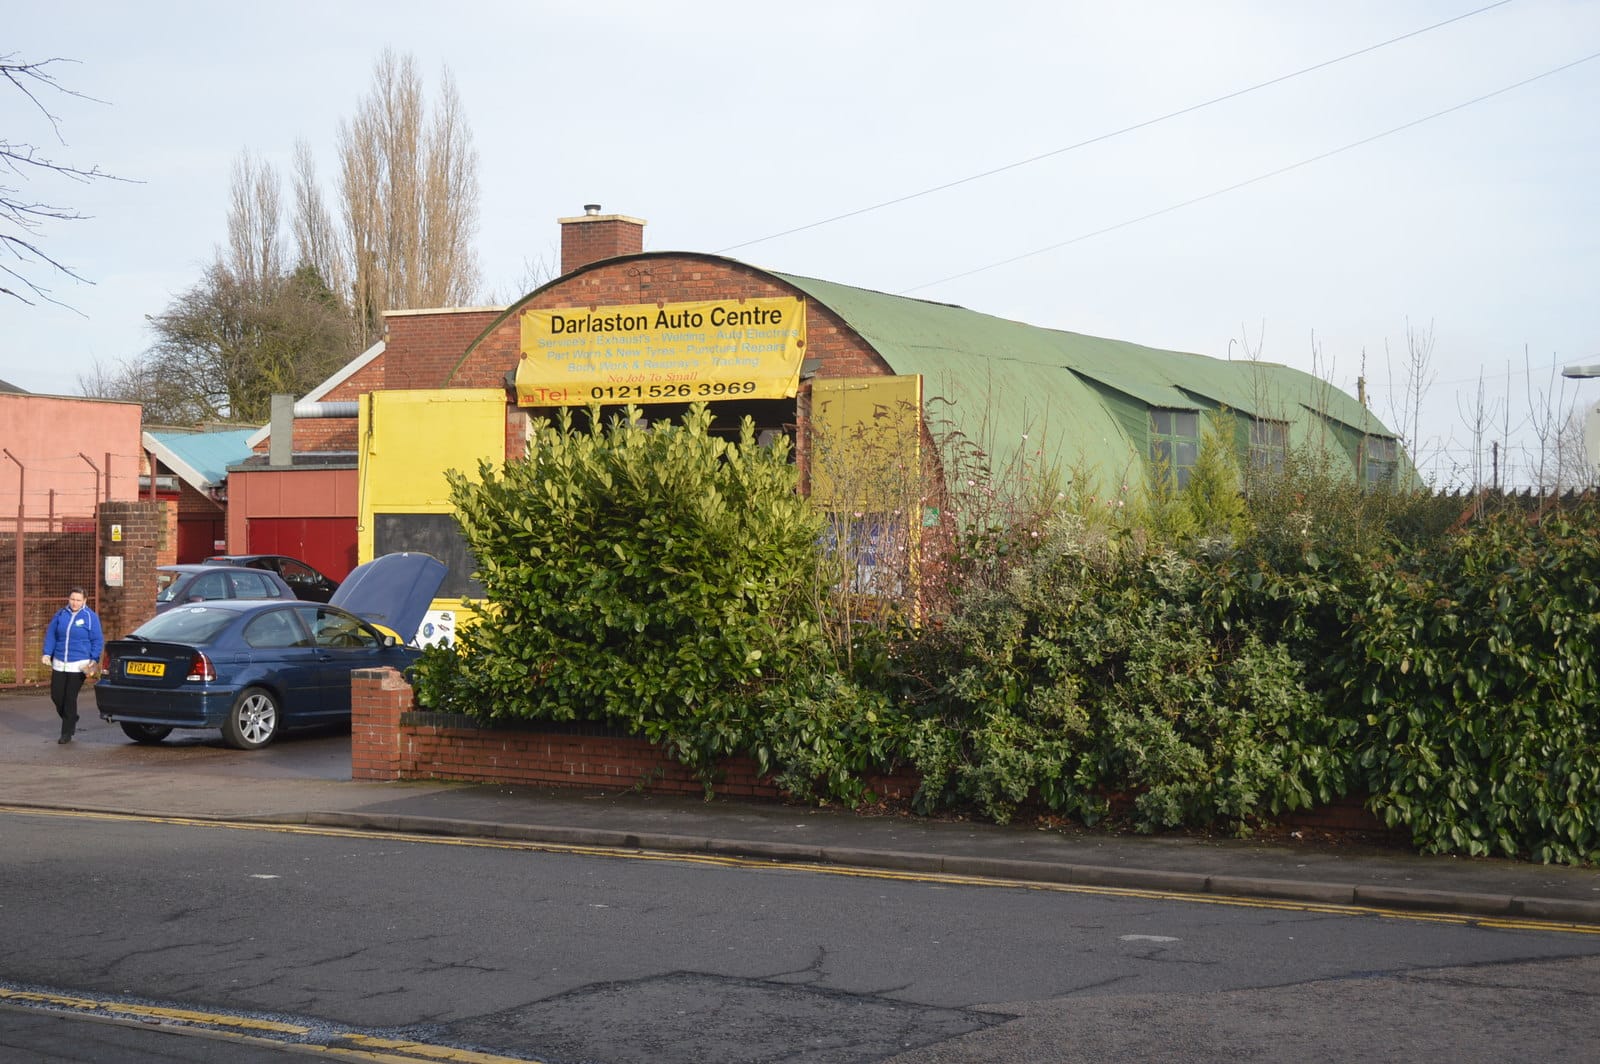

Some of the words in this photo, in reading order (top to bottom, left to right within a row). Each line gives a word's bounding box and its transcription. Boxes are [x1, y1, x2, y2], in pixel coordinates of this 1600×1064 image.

[551, 314, 648, 335] Darlaston
[654, 310, 704, 329] Auto
[710, 306, 782, 327] Centre
[661, 332, 706, 343] Welding
[717, 330, 743, 340] Auto
[746, 328, 799, 339] Electrics
[547, 351, 570, 361] Part
[572, 349, 602, 359] Worn
[605, 348, 613, 358] &
[616, 347, 641, 357] New
[645, 346, 675, 357] Tyres
[686, 344, 737, 354] Puncture
[741, 342, 786, 353] Repairs
[567, 362, 596, 373] Body
[600, 360, 628, 370] Work
[632, 359, 640, 369] &
[712, 356, 759, 368] Tracking
[607, 374, 623, 383] No
[625, 373, 645, 383] Job
[649, 372, 662, 381] To
[666, 371, 698, 382] Small
[591, 386, 642, 399] 0121
[648, 384, 691, 398] 526
[697, 381, 756, 396] 3969
